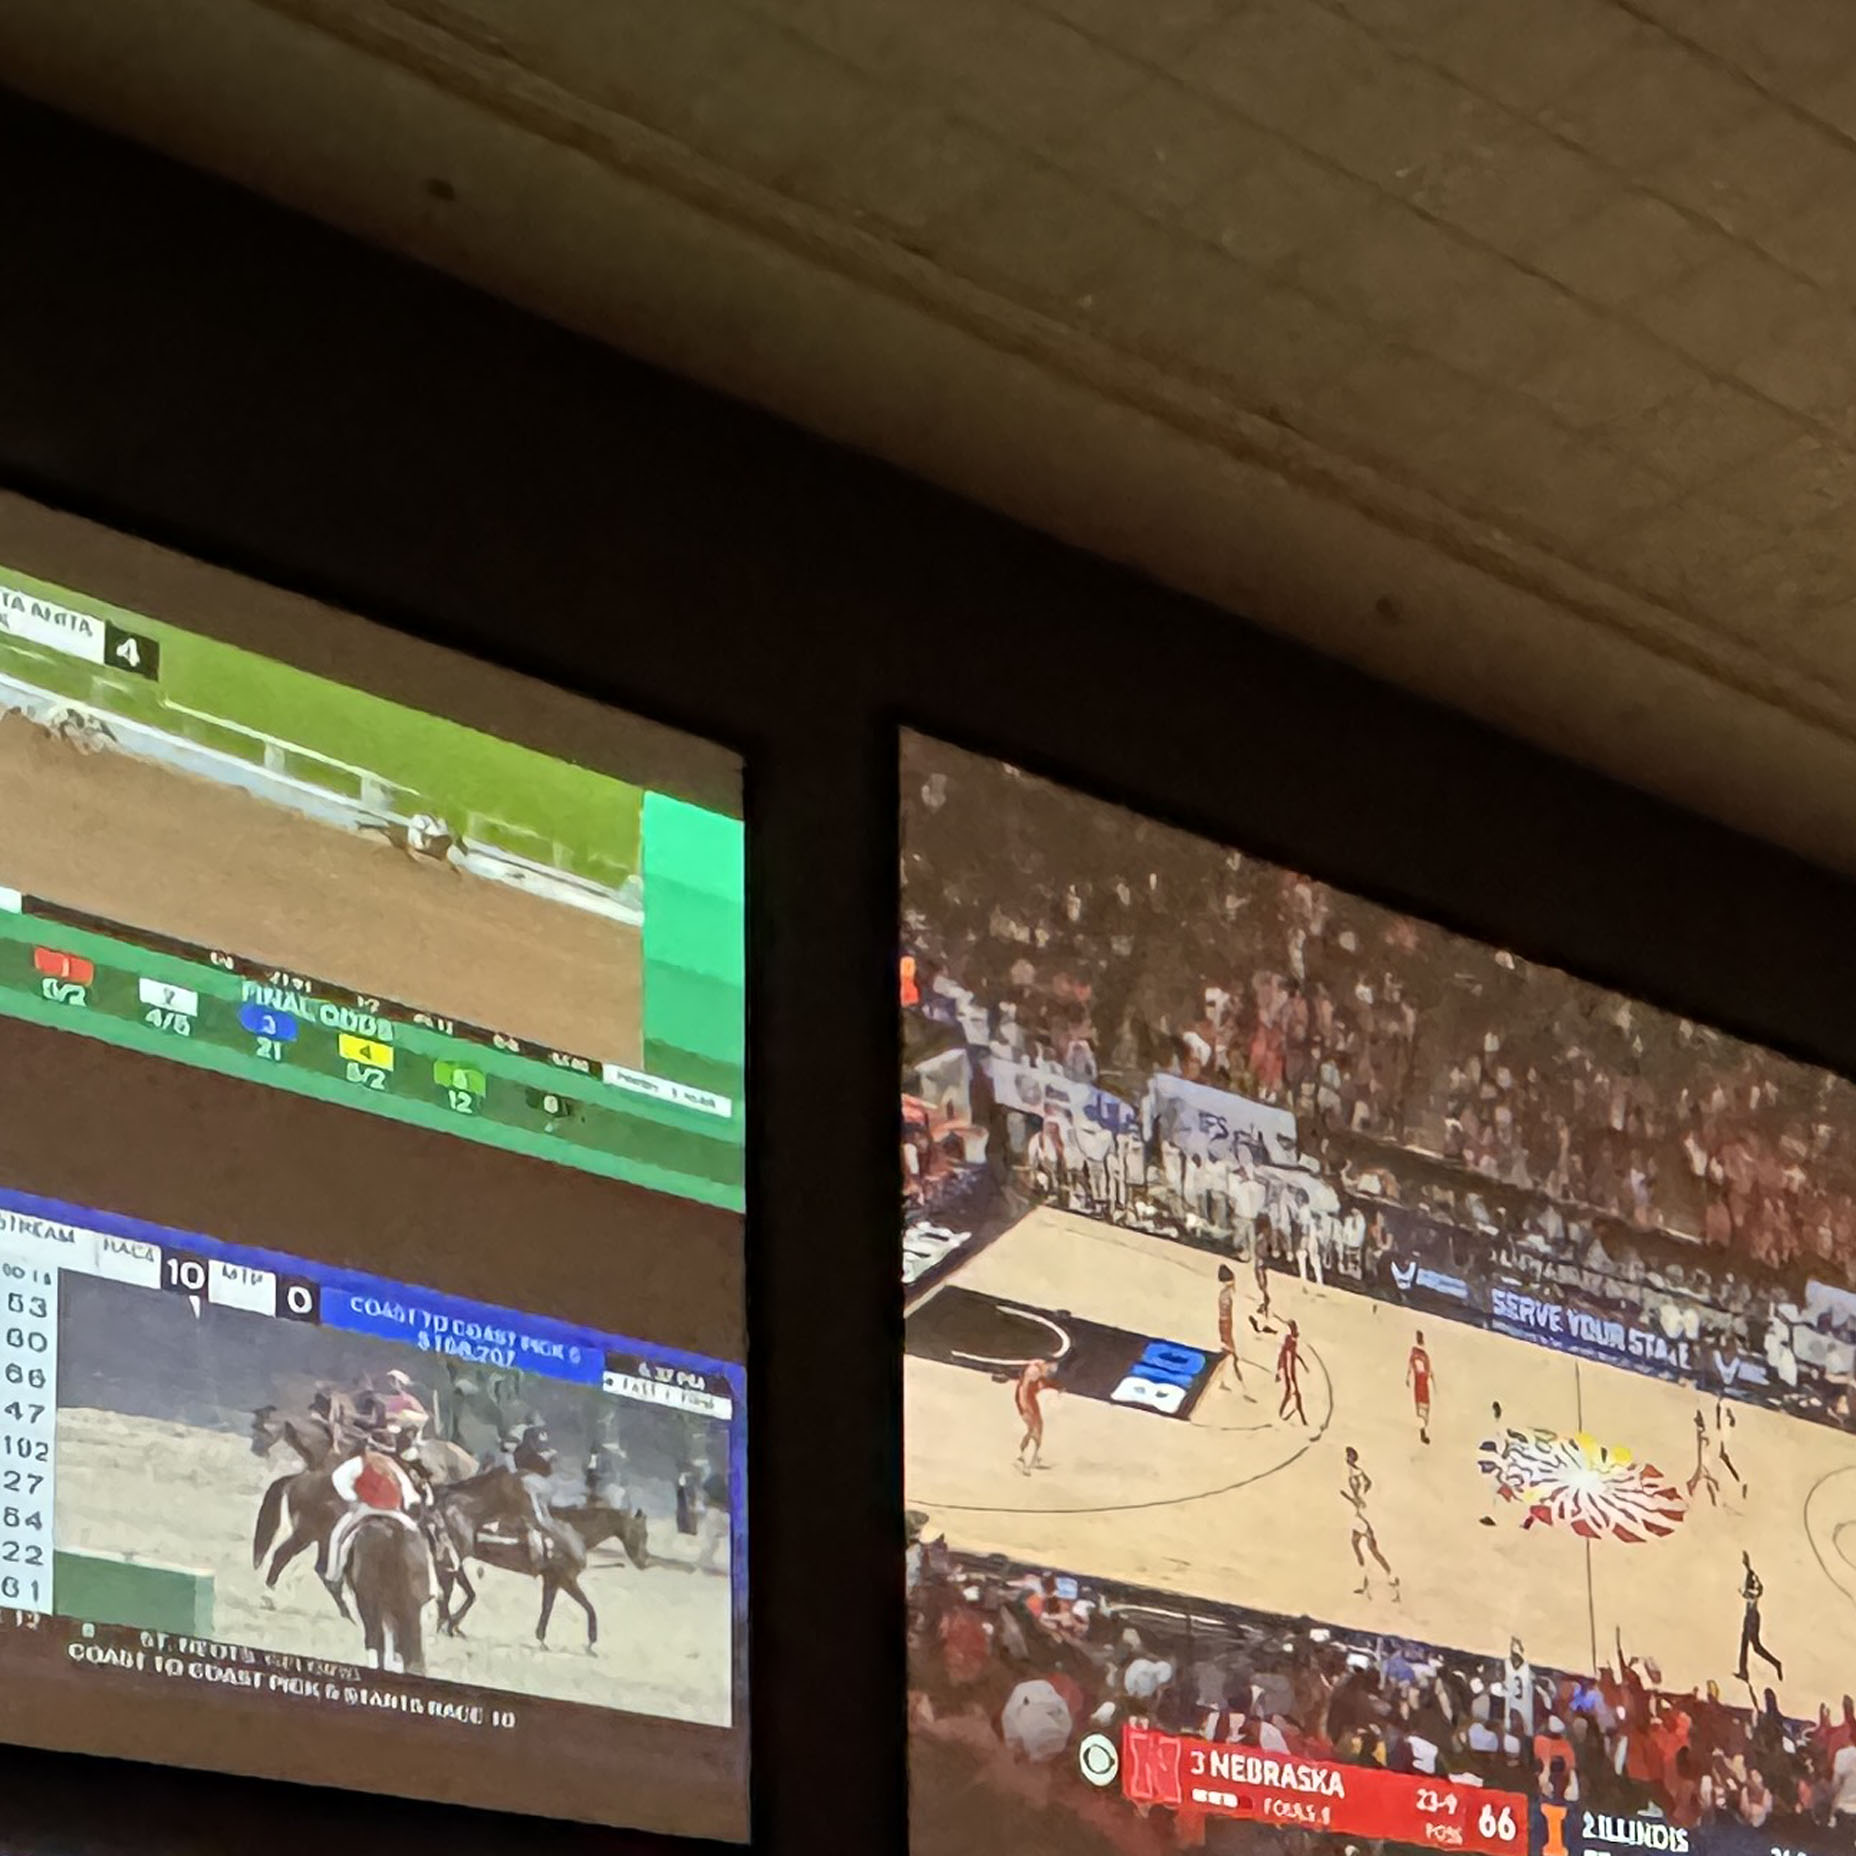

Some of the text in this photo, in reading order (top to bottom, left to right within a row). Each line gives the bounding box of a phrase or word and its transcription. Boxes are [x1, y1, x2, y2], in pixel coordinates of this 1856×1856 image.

[116, 637, 141, 668] 4
[242, 981, 315, 1024] FINAL
[448, 1090, 473, 1115] 12
[167, 1260, 206, 1290] 10
[1491, 1289, 1562, 1332] SERVE
[1567, 1306, 1628, 1350] YOUR
[3, 1401, 45, 1424] 47
[3, 1471, 45, 1494] 27
[2, 1541, 44, 1566] 22
[1190, 1749, 1205, 1775] 3
[1209, 1753, 1345, 1798] NEBRASKA
[1478, 1804, 1516, 1842] 66
[1597, 1814, 1689, 1852] ILLINOIS
